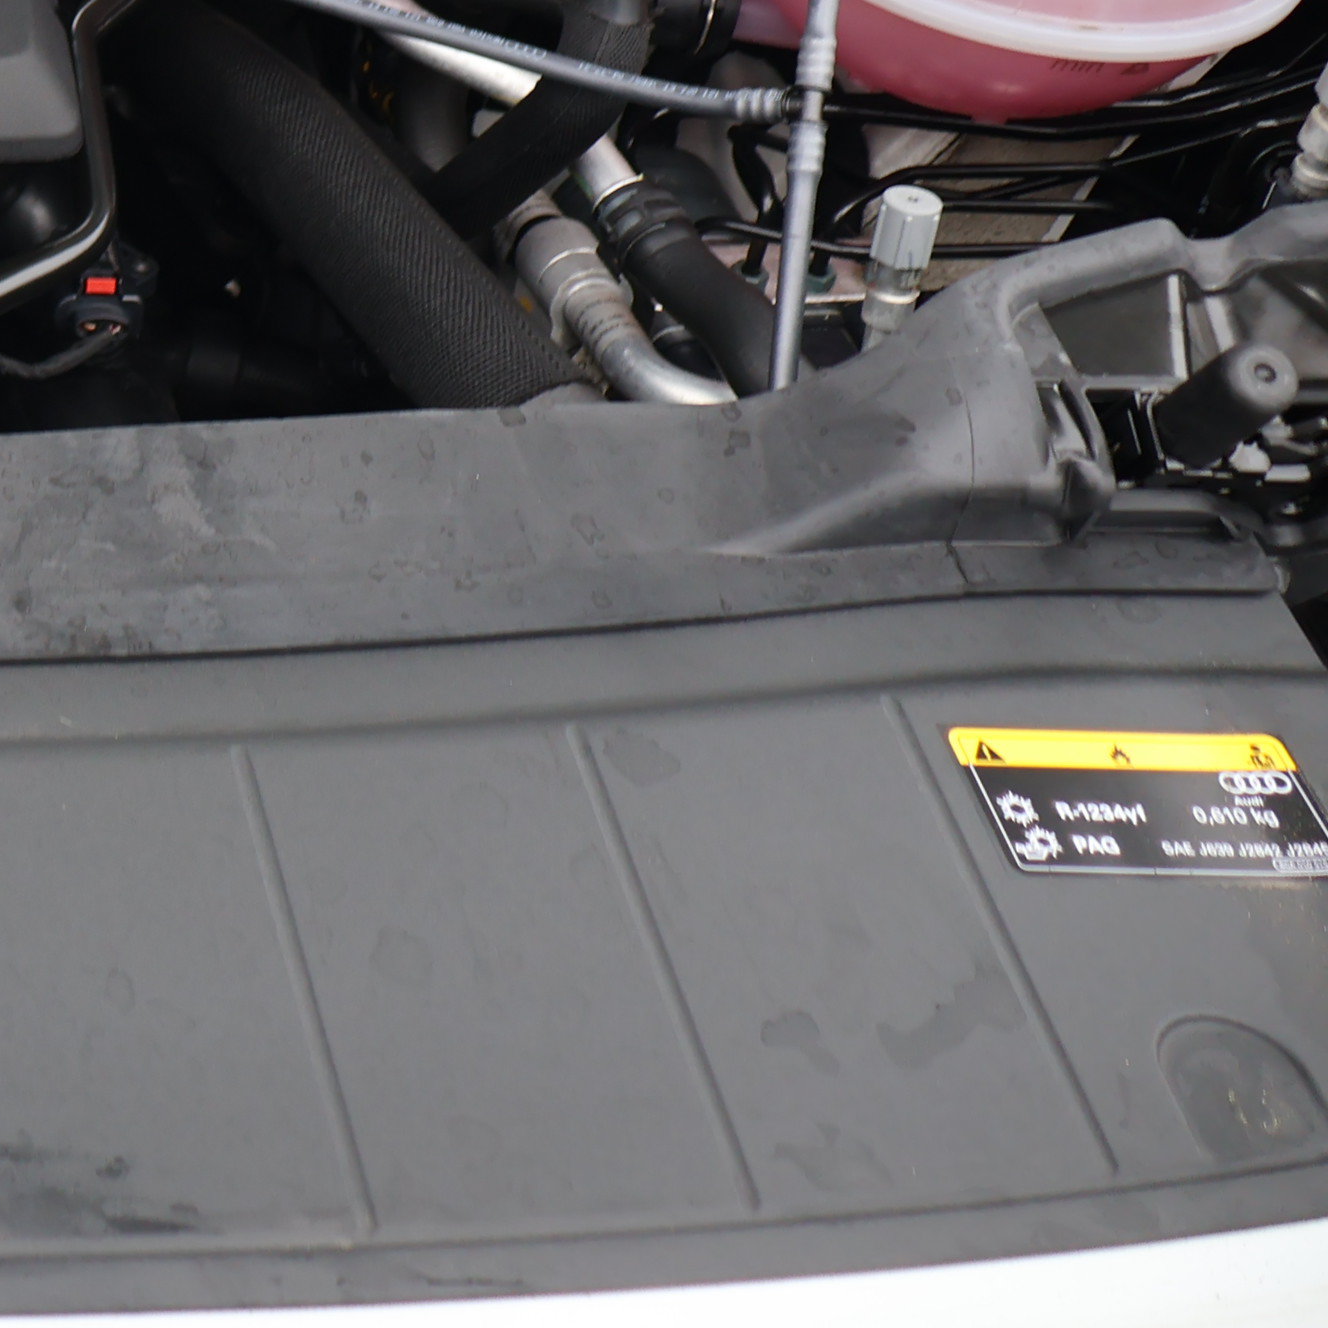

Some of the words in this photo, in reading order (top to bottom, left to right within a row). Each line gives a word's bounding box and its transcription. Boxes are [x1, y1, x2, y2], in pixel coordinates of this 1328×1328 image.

[1054, 800, 1148, 826] R-1234yf
[1250, 806, 1280, 829] kg
[1072, 834, 1121, 856] PAG
[1161, 840, 1196, 858] SAE
